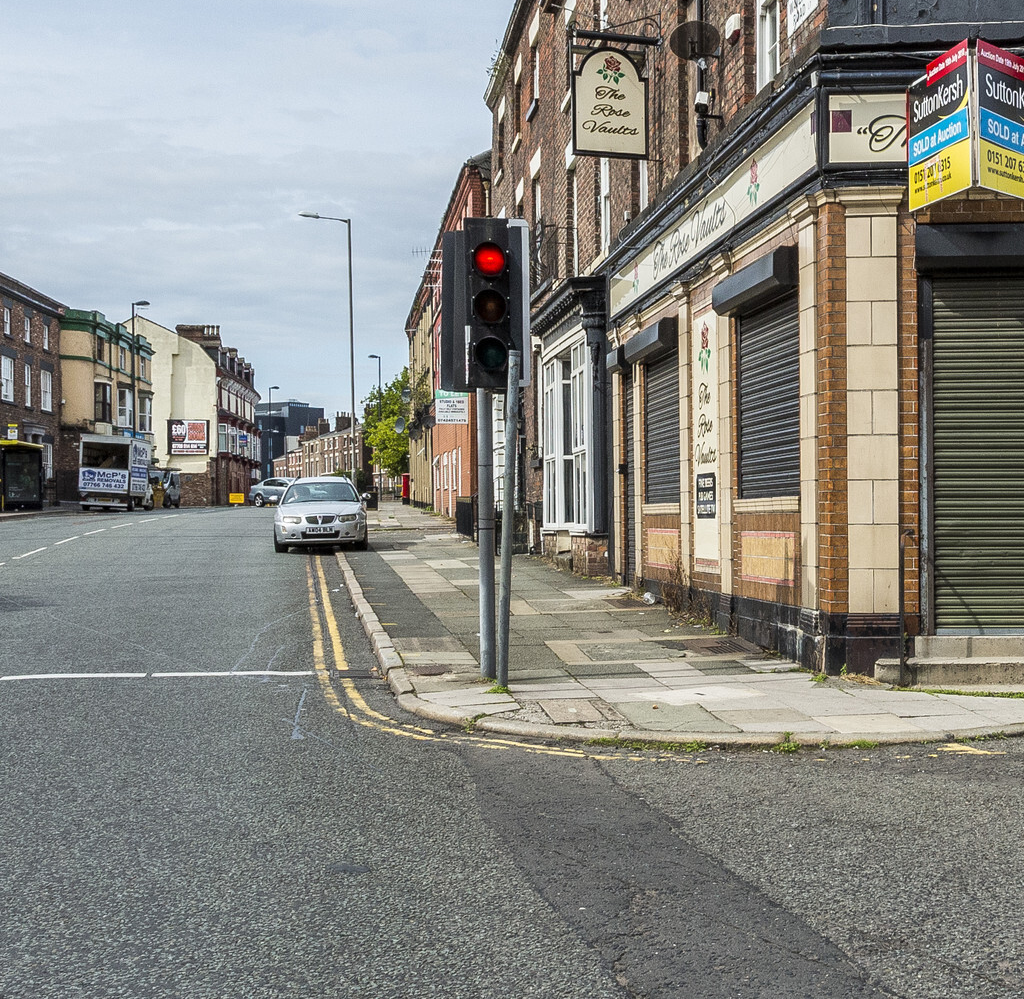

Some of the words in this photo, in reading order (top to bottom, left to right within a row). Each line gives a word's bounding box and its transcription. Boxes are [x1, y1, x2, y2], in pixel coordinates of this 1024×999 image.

[981, 49, 996, 62] Auction
[996, 54, 1004, 65] Date
[595, 85, 626, 101] The
[914, 73, 964, 123] SuttonKersh
[590, 103, 631, 117] Rose
[582, 119, 640, 135] Vaults
[913, 135, 930, 157] SOLD
[930, 133, 937, 145] at
[937, 120, 962, 145] Auction
[988, 118, 1010, 141] SOLD
[1011, 131, 1019, 144] at
[987, 149, 1003, 166] 0151
[1005, 155, 1017, 170] 207
[653, 238, 668, 281] The
[669, 227, 690, 268] Rose
[690, 197, 726, 247] Vaults
[699, 382, 711, 410] The
[697, 413, 713, 438] Rose
[695, 441, 717, 467] Vaults
[97, 471, 126, 479] McP's
